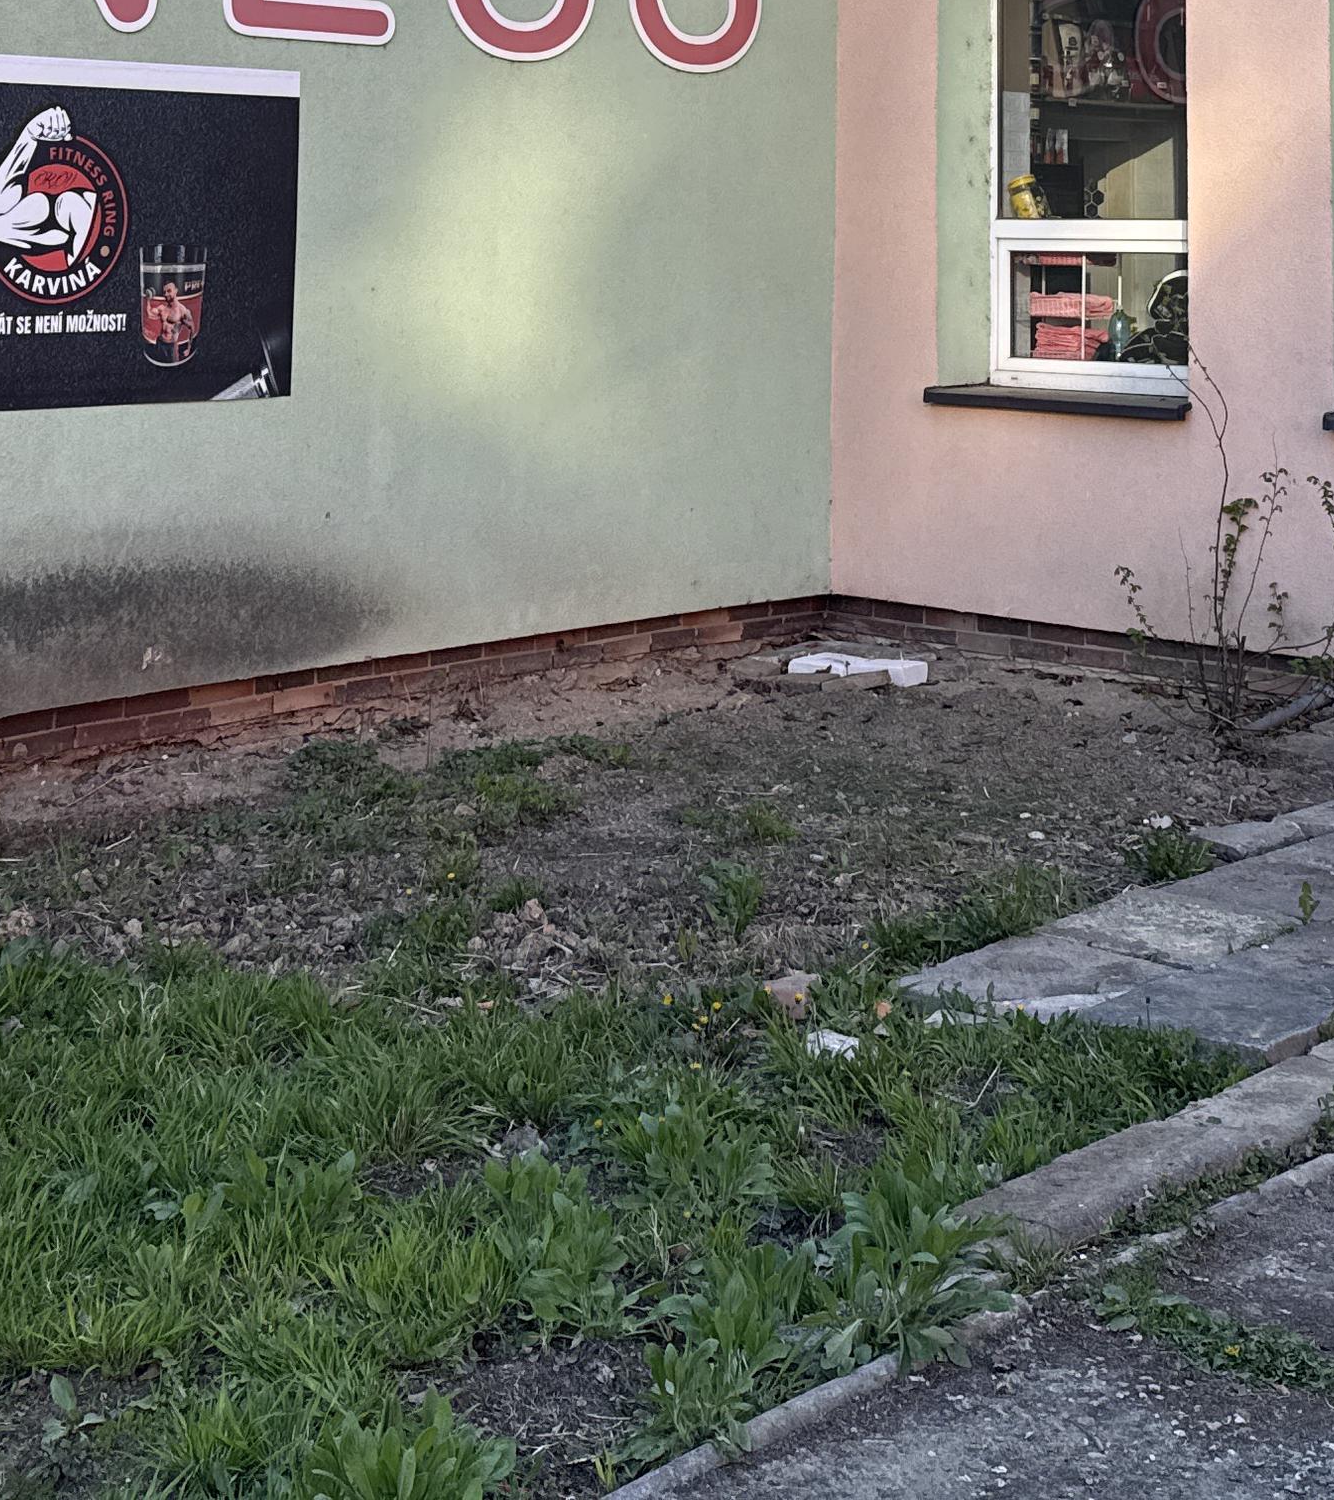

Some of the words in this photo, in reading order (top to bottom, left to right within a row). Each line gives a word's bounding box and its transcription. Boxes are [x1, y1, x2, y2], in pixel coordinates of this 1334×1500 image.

[49, 146, 108, 187] FITNESS
[101, 190, 117, 237] RING
[3, 257, 102, 296] KARVINÁ
[16, 317, 32, 334] SE
[35, 311, 63, 334] NENÍ
[66, 309, 127, 333] MOŽNOST!
